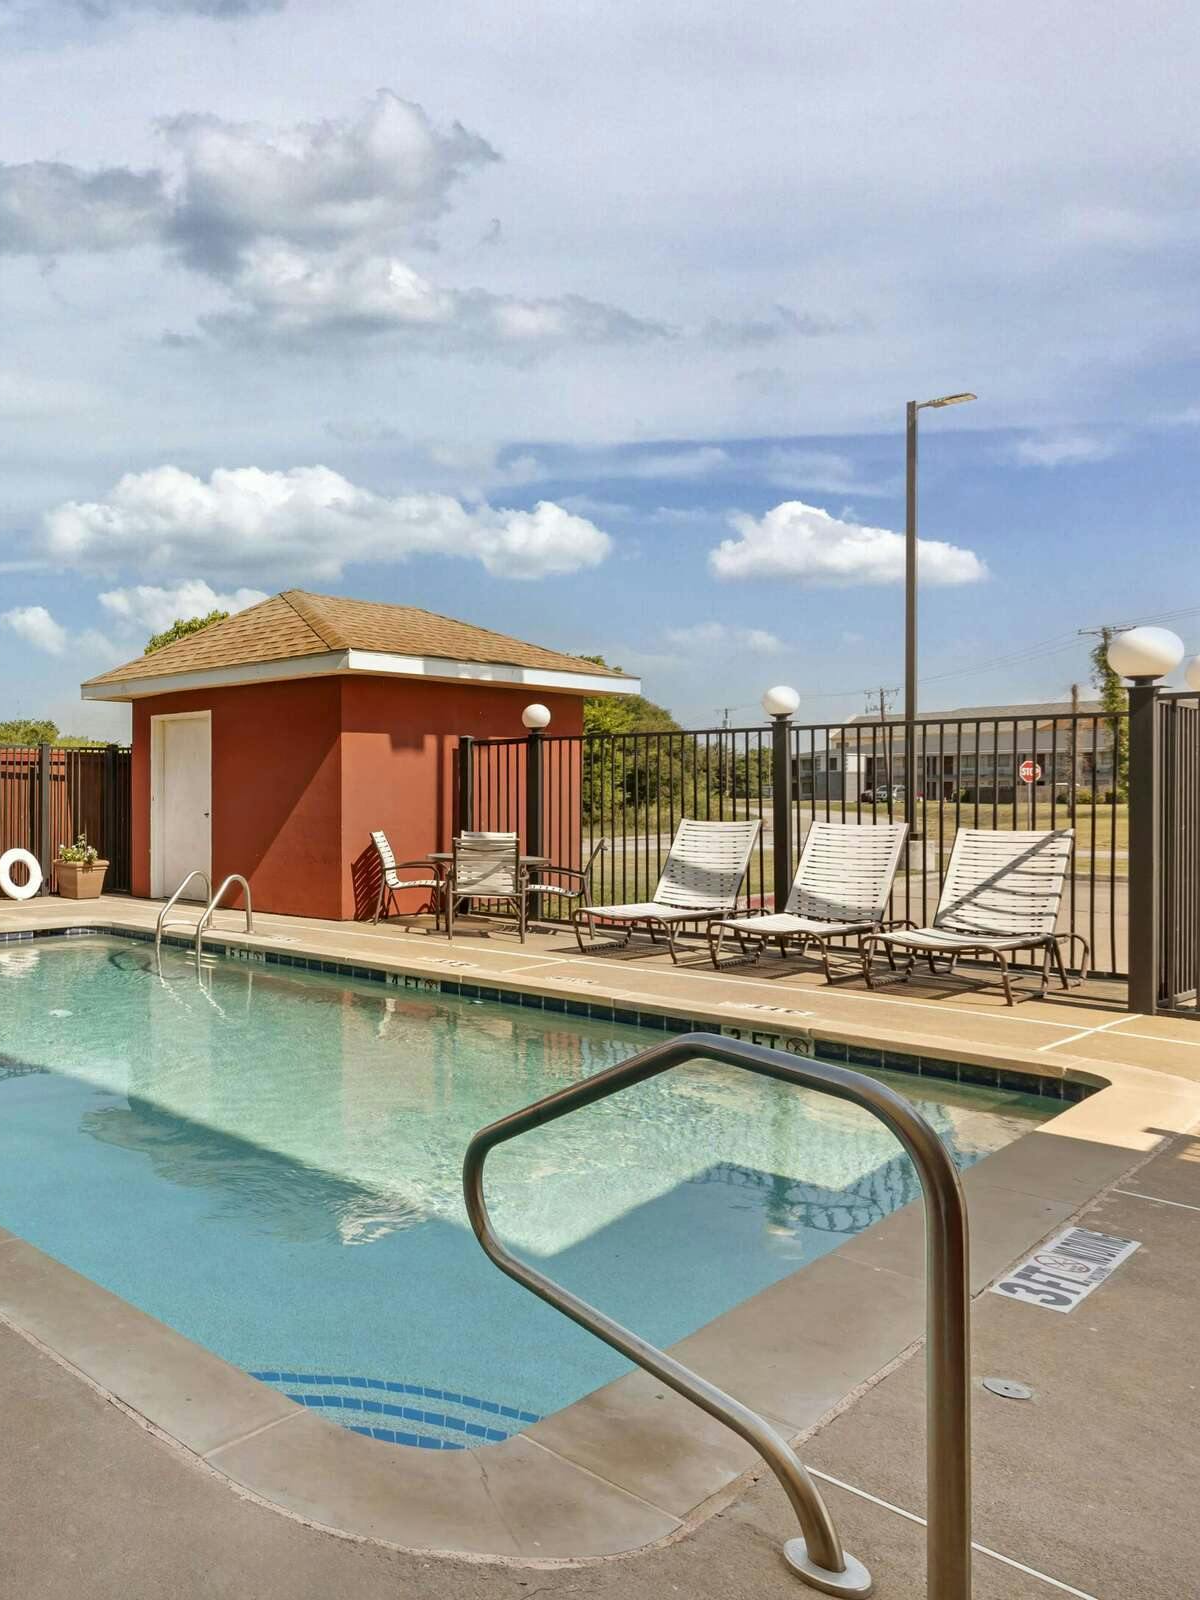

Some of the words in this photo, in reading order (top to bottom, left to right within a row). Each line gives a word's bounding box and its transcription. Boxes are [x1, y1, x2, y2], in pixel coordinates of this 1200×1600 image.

[404, 975, 422, 988] FT
[752, 1031, 781, 1050] FT
[998, 1281, 1073, 1306] 3
